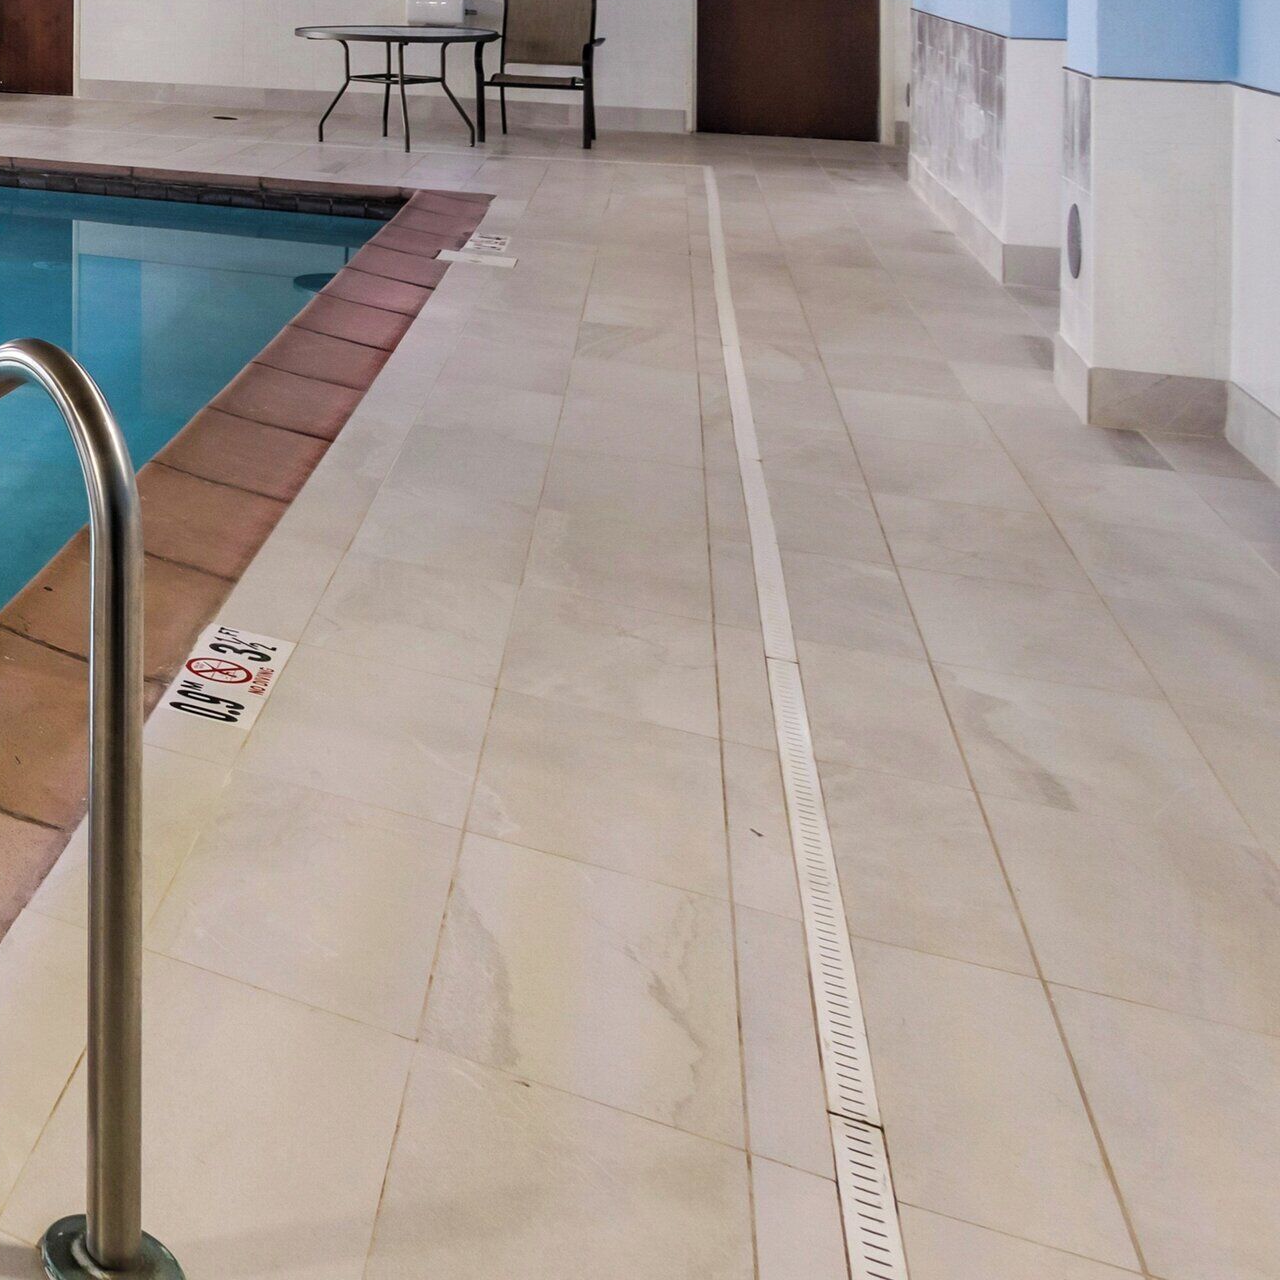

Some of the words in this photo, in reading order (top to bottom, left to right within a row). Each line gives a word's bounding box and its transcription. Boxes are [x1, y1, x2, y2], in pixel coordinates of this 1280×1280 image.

[218, 627, 239, 637] FT
[252, 667, 275, 687] DIVING
[180, 679, 204, 691] M
[248, 685, 266, 696] NO
